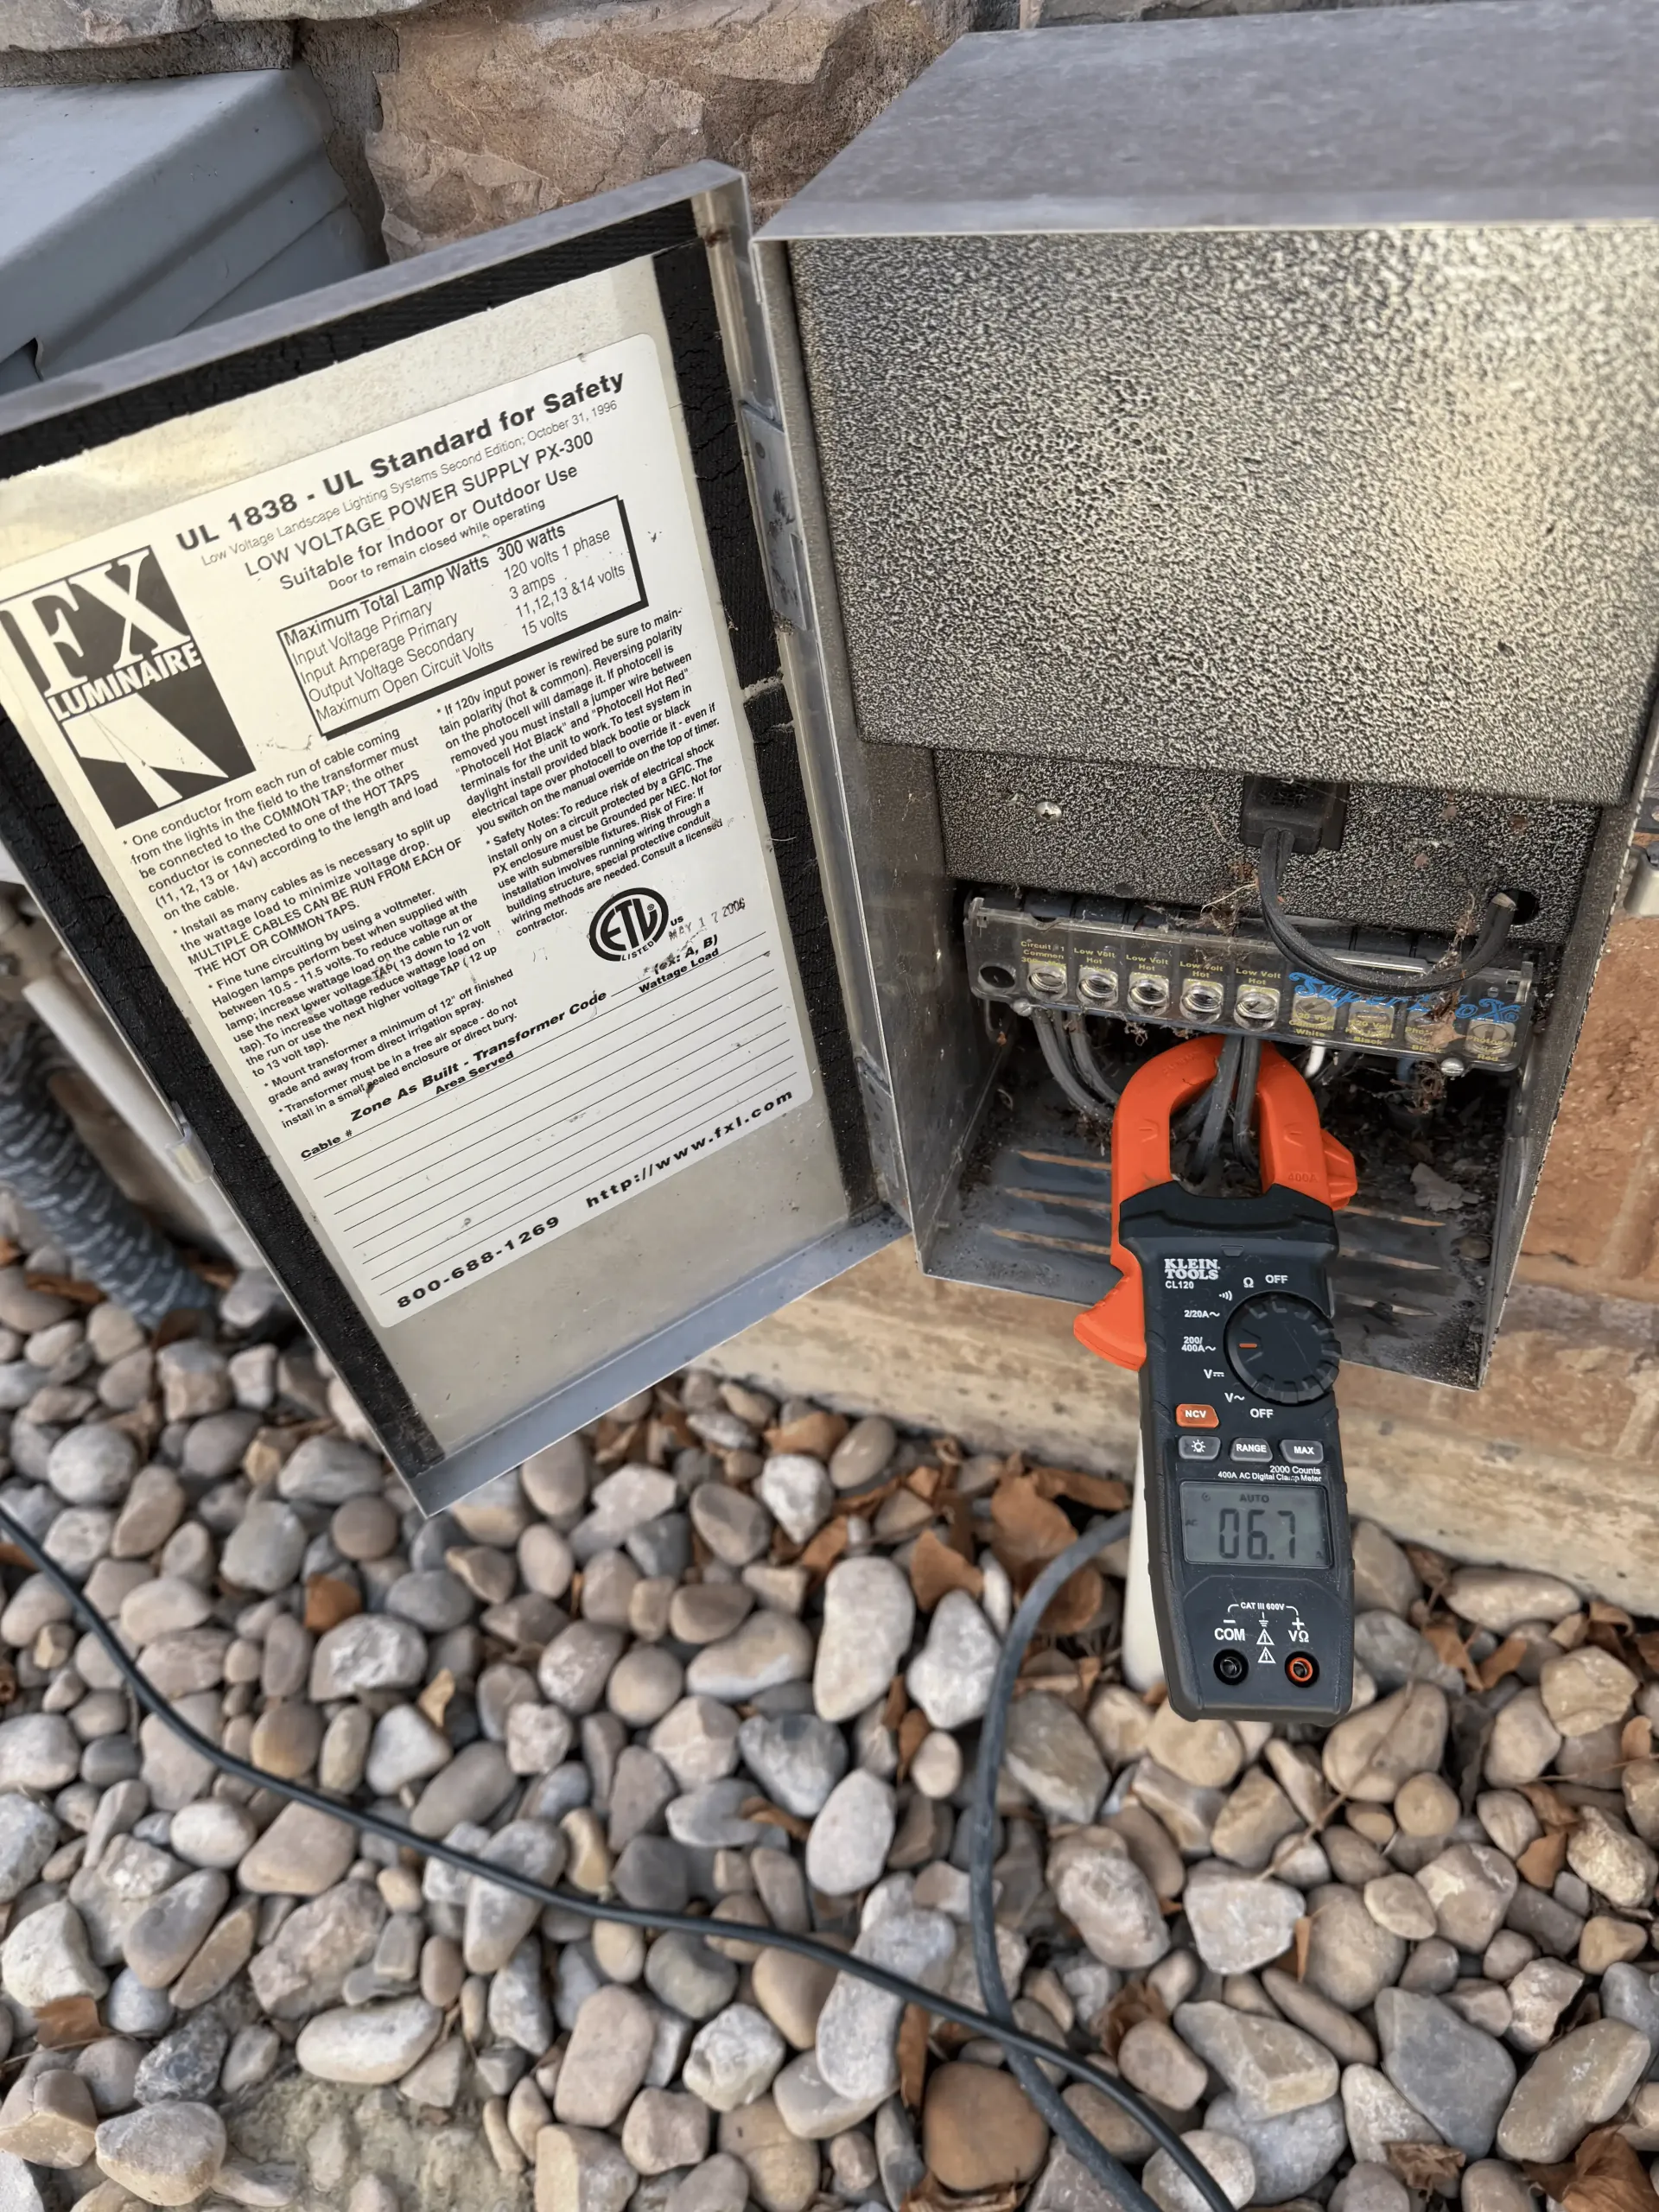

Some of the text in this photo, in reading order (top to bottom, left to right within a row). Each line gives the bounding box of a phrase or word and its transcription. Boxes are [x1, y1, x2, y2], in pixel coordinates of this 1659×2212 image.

[175, 524, 219, 550] UL
[227, 493, 297, 531] 1838
[321, 469, 364, 495] UL
[369, 417, 493, 479] Standard
[498, 404, 535, 431] for
[543, 372, 623, 414] Safety
[200, 398, 617, 566] Low Voltage Landscape Lighting Systems Second Edition; October 31, 1996
[244, 430, 593, 576] LOW VOLTAGE POWER SUPPLY PX-300
[279, 466, 577, 589] Suitable for Indoor or Outdoor Use
[327, 499, 545, 590] Door to remain closed while operating
[283, 524, 565, 646] Maximum Total Lamp Watts 300 watts
[291, 529, 610, 665] Input Voltage Primary 120 volts 1 phase
[0, 548, 191, 698] FX
[308, 675, 354, 702] Output
[353, 656, 404, 683] Voltage
[406, 626, 474, 662] Secondary
[515, 586, 569, 617] 11,12,13
[596, 564, 625, 583] volts
[315, 609, 568, 721] Maximum Open Circuit Volts 15 volts
[46, 642, 202, 721] LUMINAIRE
[454, 667, 688, 776] "Photocell Hot Black" and "Photocell Hot Red"
[131, 728, 400, 845] One conductor from each run of cable coming
[600, 898, 658, 952] ETL
[668, 921, 692, 942] MAY
[621, 940, 656, 962] LISTED
[683, 945, 699, 958] A,
[702, 933, 718, 949] B)
[1020, 941, 1052, 950] Circuit
[1023, 950, 1065, 960] Common
[1096, 950, 1116, 958] Volt
[639, 948, 719, 993] Wattage Load
[1149, 957, 1169, 965] Volt
[1204, 963, 1224, 972] olt
[1236, 967, 1257, 976] Low
[349, 1096, 391, 1122] Zone
[397, 1084, 417, 1100] As
[421, 1062, 459, 1087] Built
[472, 1011, 565, 1061] Transformer
[568, 989, 607, 1014] Code
[435, 1049, 514, 1095] Area Served
[300, 1135, 341, 1159] Cable
[585, 1090, 792, 1208] http://www.fxl.com
[396, 1216, 559, 1308] 800-688-1269
[1164, 1258, 1219, 1269] KLEIN
[1164, 1269, 1219, 1280] TOOLS
[1165, 1281, 1194, 1289] CL120
[1265, 1274, 1289, 1284] OFF
[1183, 1336, 1203, 1345] 200/
[1185, 1409, 1206, 1419] NCV
[1249, 1408, 1274, 1418] OFF
[1236, 1444, 1267, 1453] RANGE
[1294, 1446, 1315, 1455] MAX
[1252, 1472, 1274, 1481] Digital
[1292, 1466, 1321, 1475] Counts
[1239, 1494, 1270, 1503] AUTO
[1219, 1508, 1296, 1560] 06.7
[1240, 1601, 1255, 1610] CAT
[1214, 1628, 1245, 1641] COM
